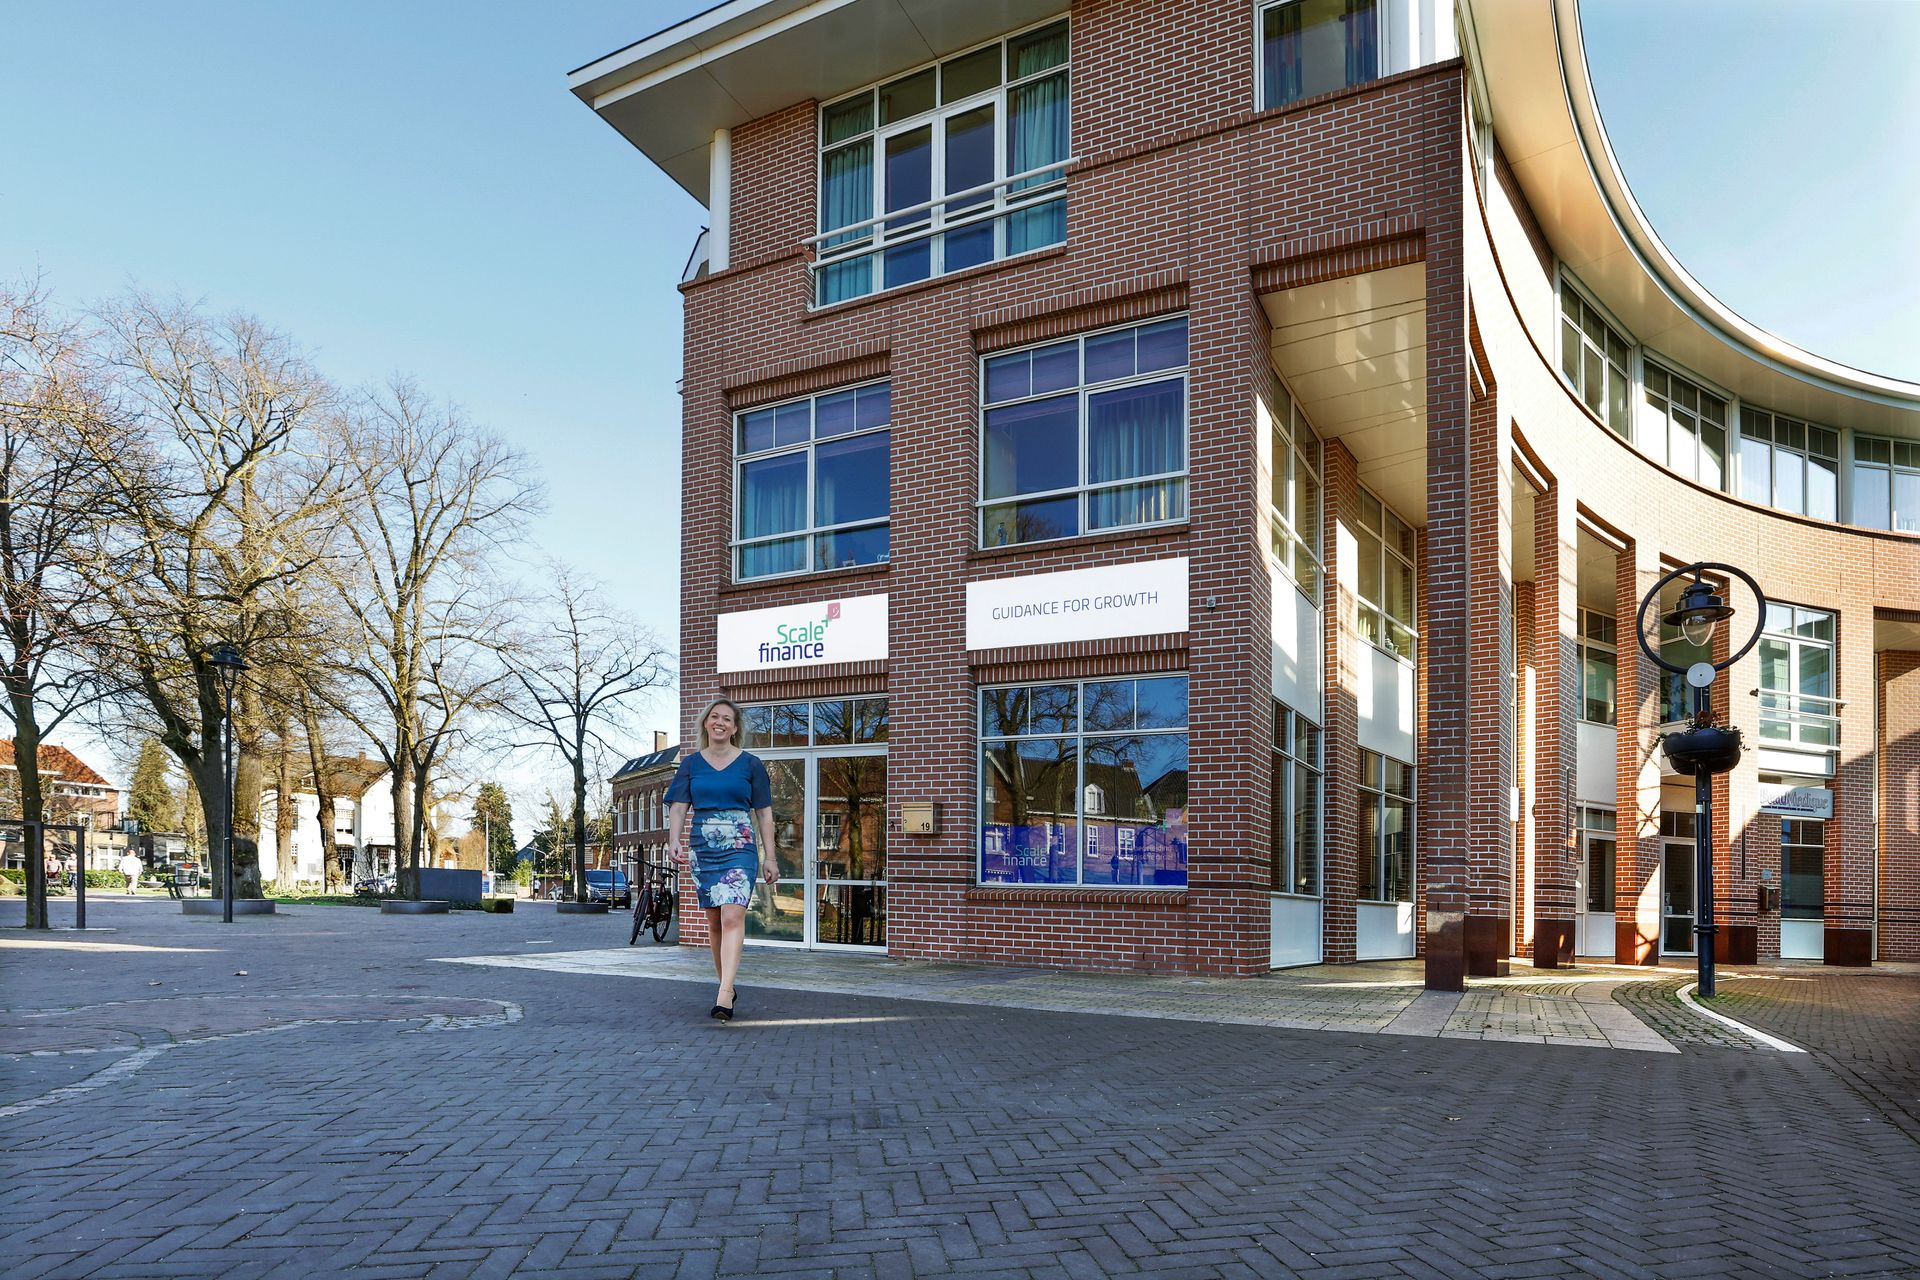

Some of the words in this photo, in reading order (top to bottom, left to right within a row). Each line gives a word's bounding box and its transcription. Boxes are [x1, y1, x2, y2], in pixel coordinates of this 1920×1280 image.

[992, 601, 1059, 620] GUIDANCE
[1063, 600, 1090, 613] FOR
[1094, 591, 1158, 610] GROWTH
[759, 642, 824, 663] finance
[921, 822, 931, 831] 19
[1015, 844, 1047, 857] Scale
[1003, 856, 1047, 866] finance
